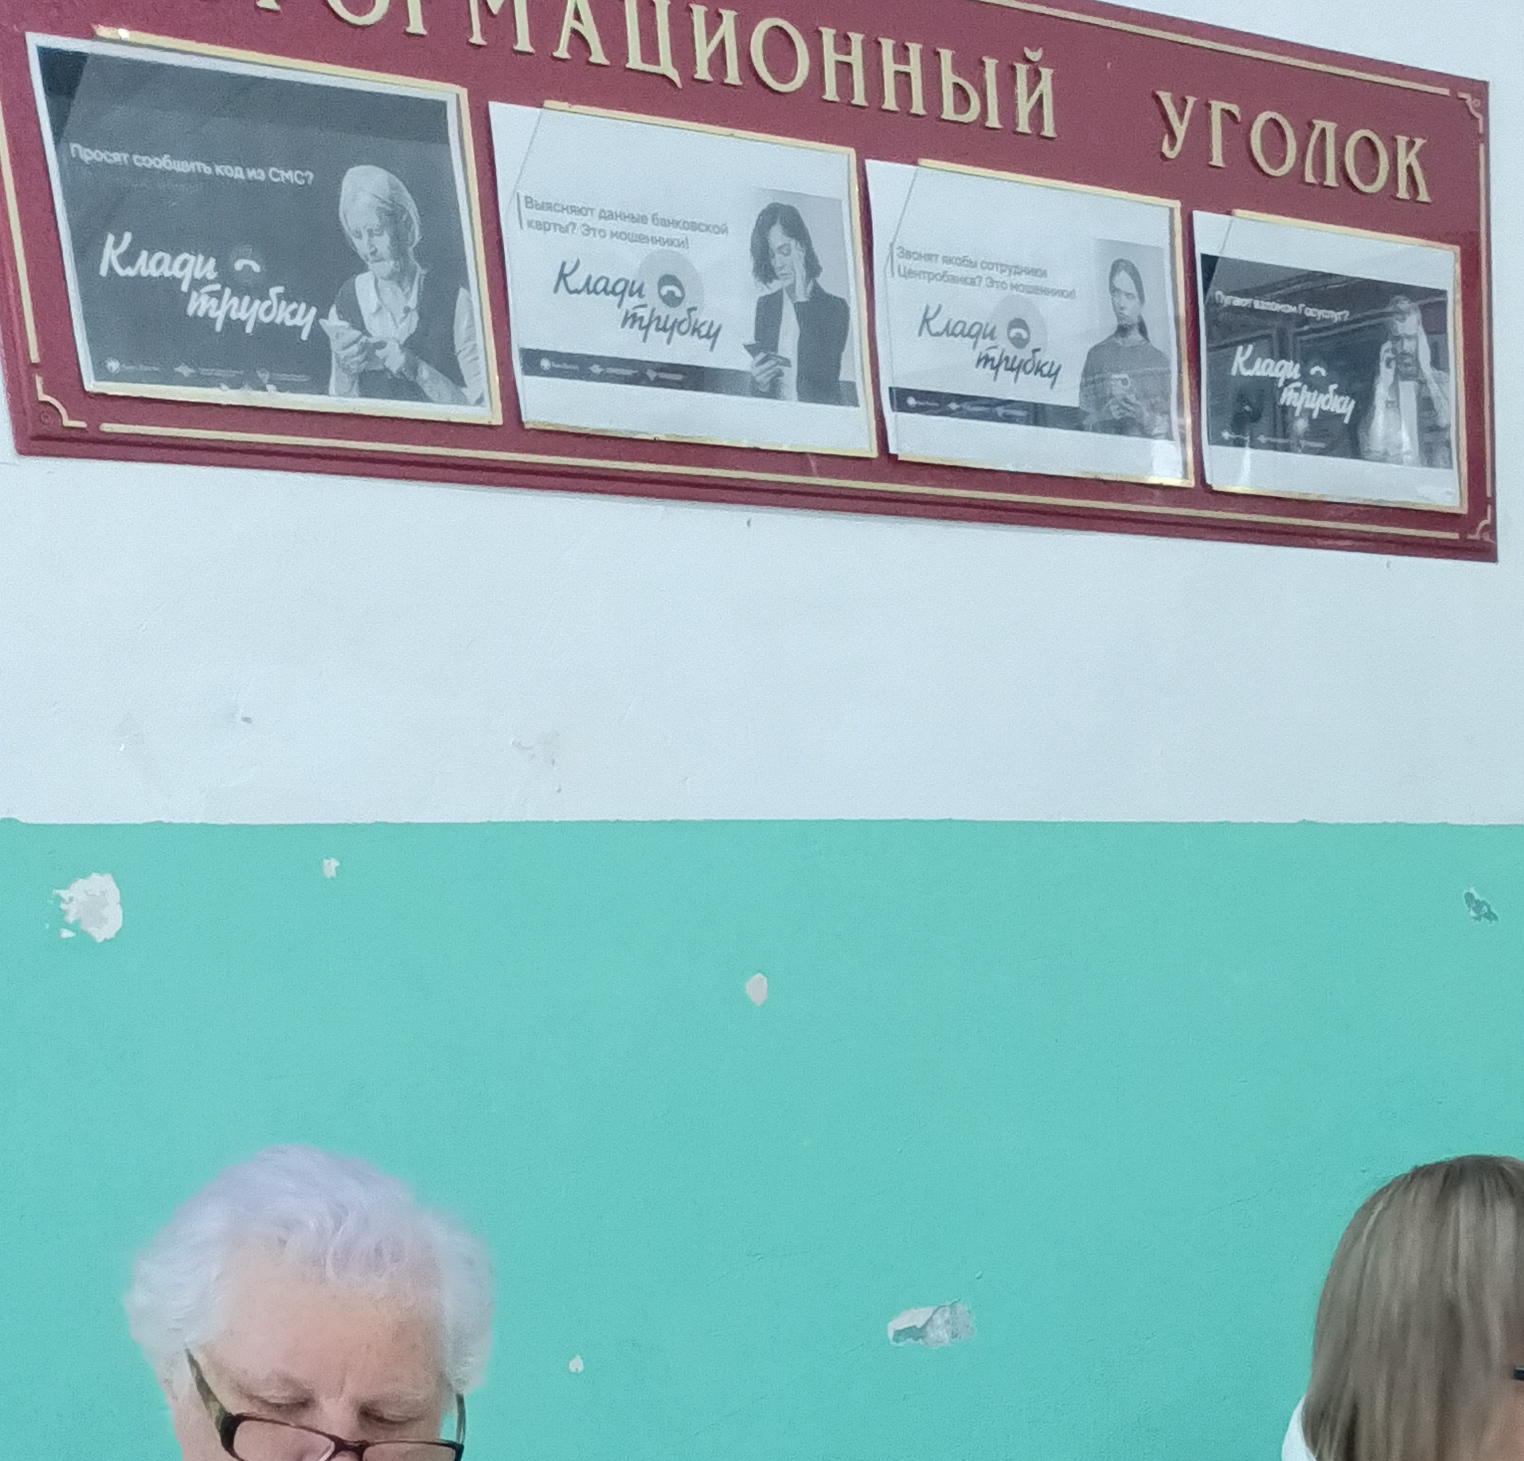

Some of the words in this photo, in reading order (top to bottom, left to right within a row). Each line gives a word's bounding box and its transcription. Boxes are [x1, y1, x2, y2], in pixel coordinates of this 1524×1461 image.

[256, 0, 1058, 139] МАЦИОННЫЙ
[1155, 89, 1432, 203] УГОЛОК
[69, 142, 129, 164] Просят
[215, 163, 246, 179] код
[247, 166, 266, 181] из
[268, 166, 315, 185] СМС?
[524, 195, 595, 217] Выясняют
[598, 207, 648, 226] данные
[651, 212, 729, 235] банковской
[526, 219, 577, 235] карты?
[581, 223, 607, 239] Это
[609, 230, 690, 249] мошенники!
[99, 231, 219, 292] Клади
[896, 246, 940, 264] Звонят
[553, 258, 646, 309] Клади
[985, 276, 1009, 291] Это
[186, 283, 317, 341] трубку
[620, 304, 723, 352] трубку
[917, 303, 998, 350] Клади
[975, 345, 1063, 390] трубку
[1231, 343, 1302, 388] Клади
[1279, 381, 1356, 424] трубку
